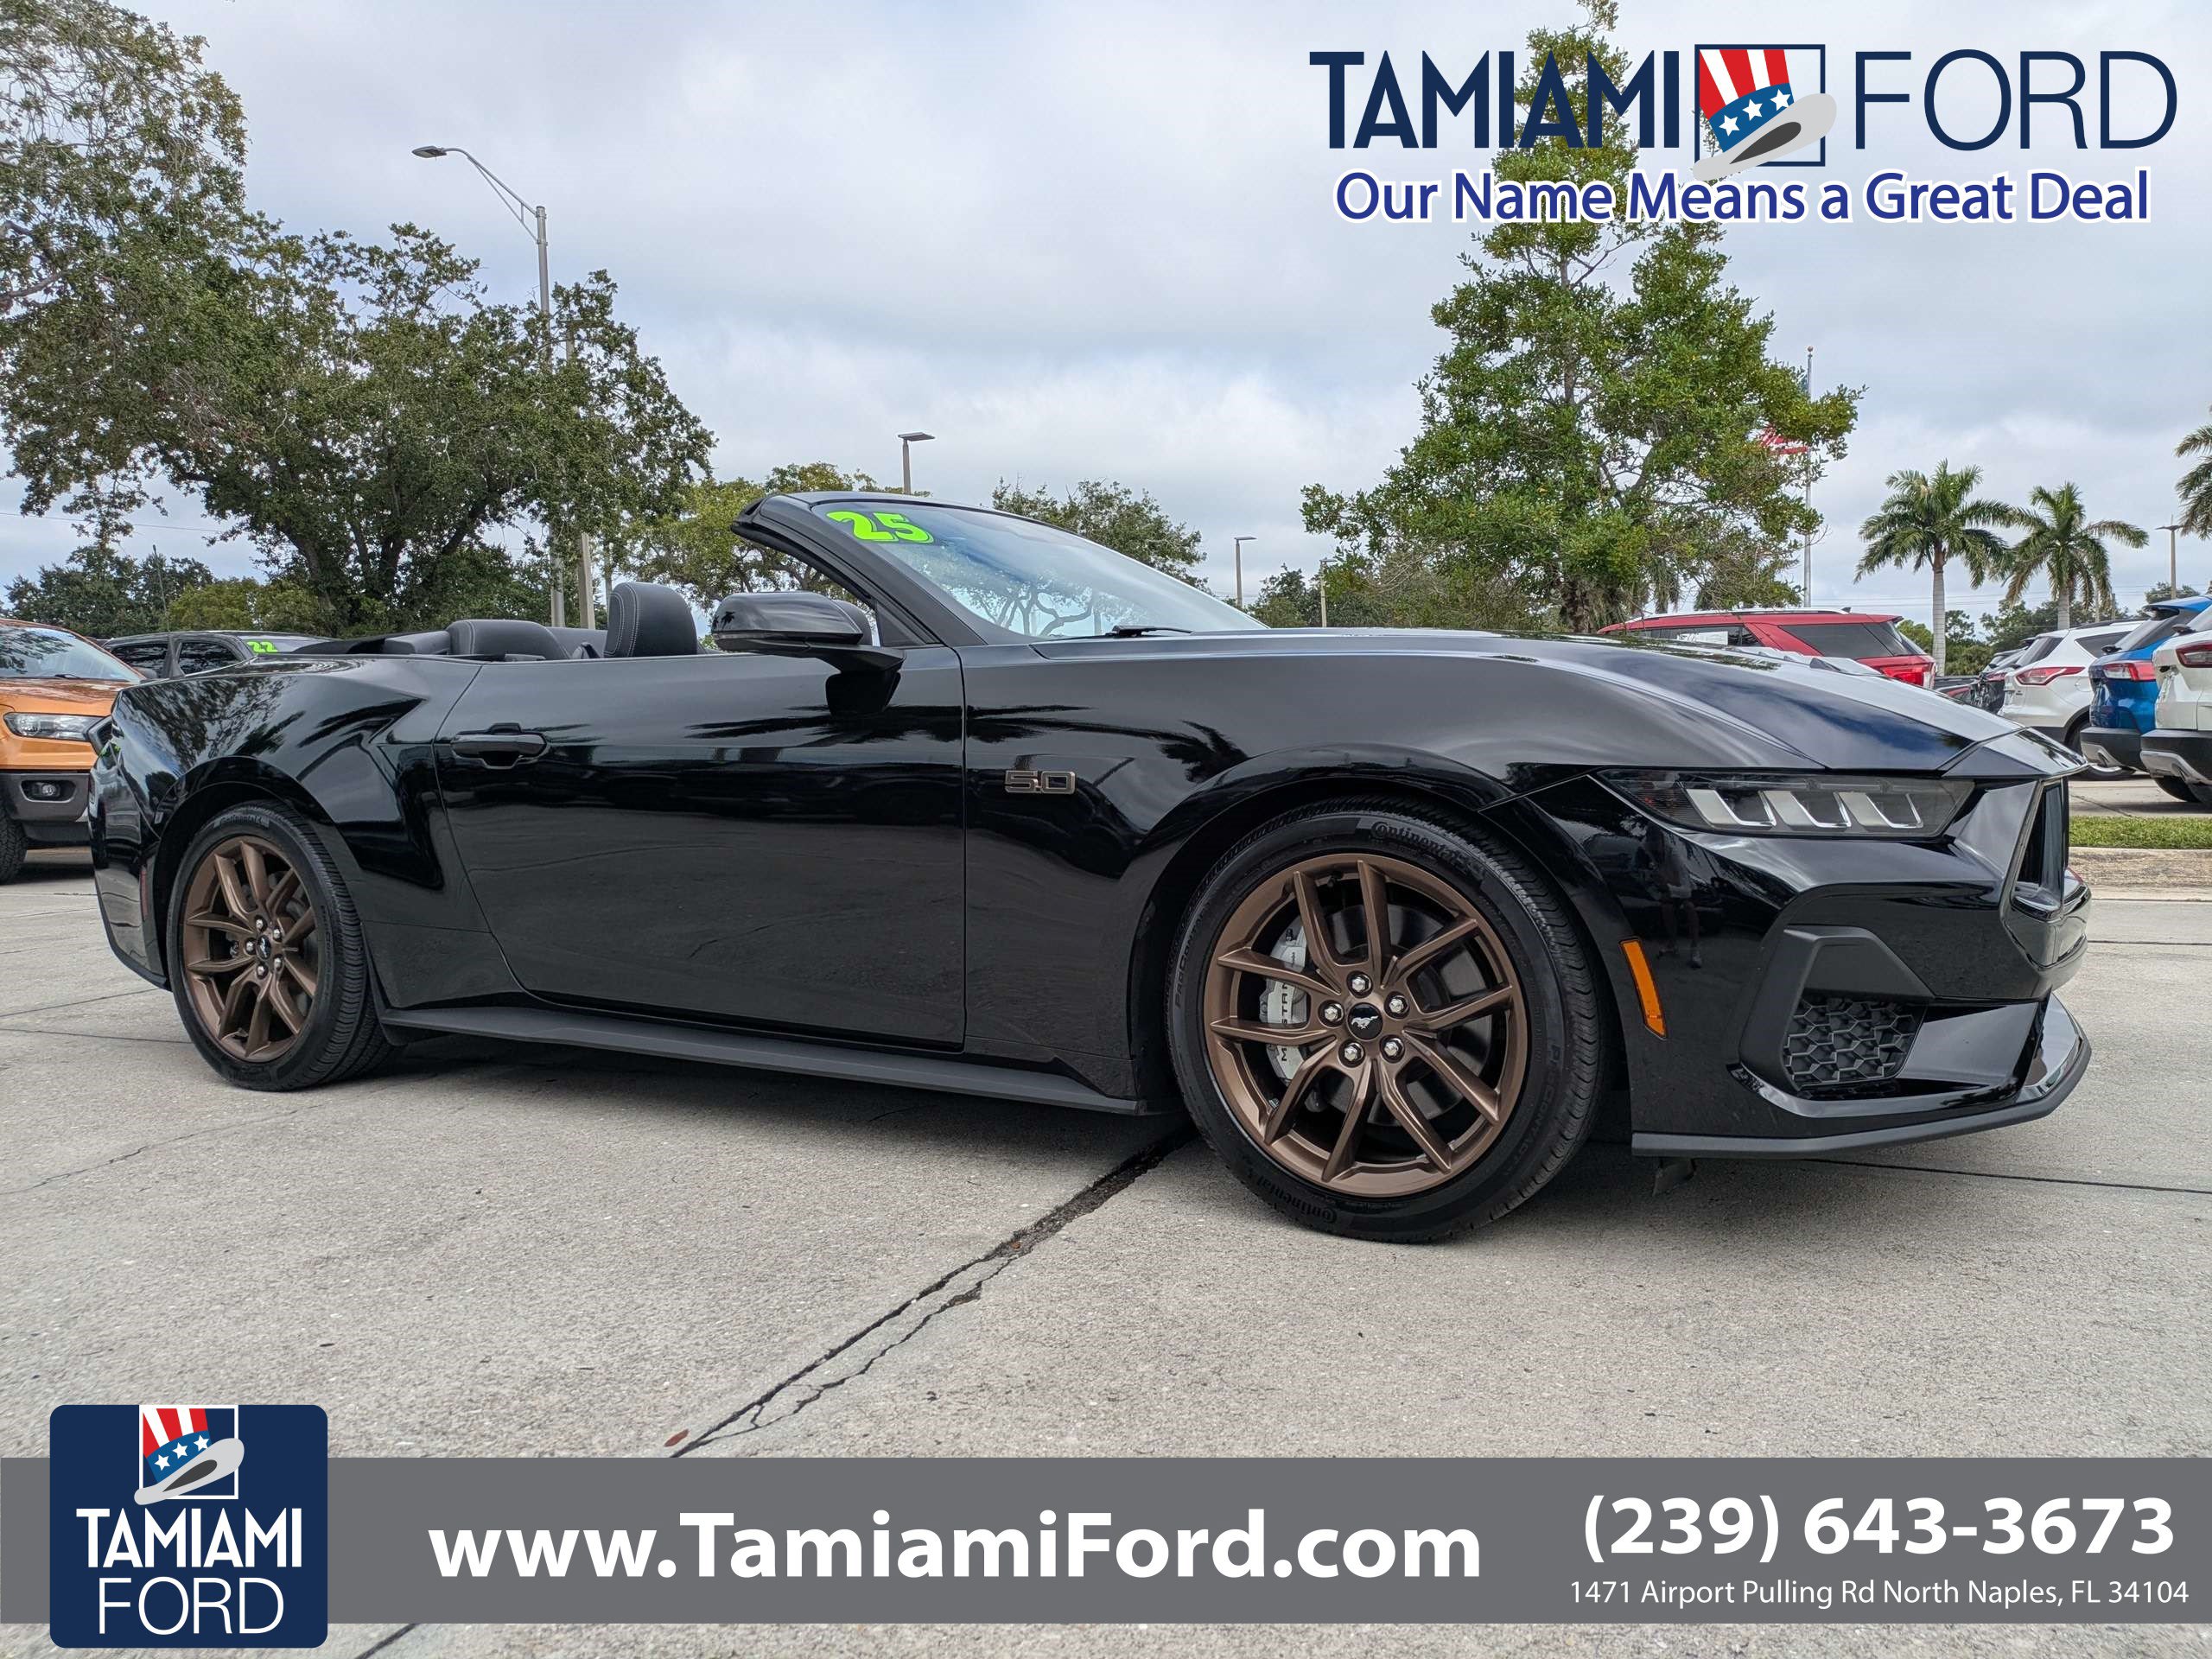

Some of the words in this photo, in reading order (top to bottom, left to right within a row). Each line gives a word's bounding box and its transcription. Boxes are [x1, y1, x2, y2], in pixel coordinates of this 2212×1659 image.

[827, 511, 934, 543] 25
[246, 640, 278, 652] 22
[1005, 770, 1076, 794] 5.0
[1370, 820, 1458, 863] Continental
